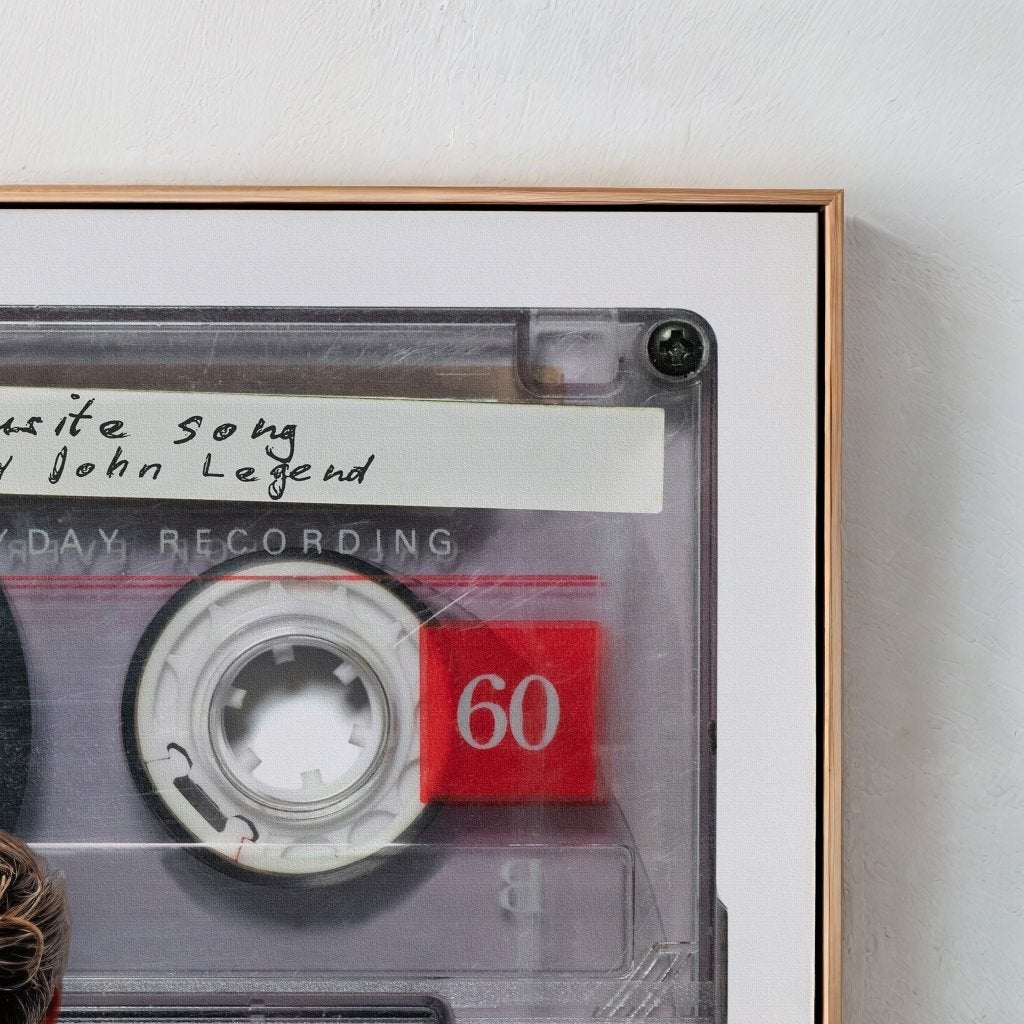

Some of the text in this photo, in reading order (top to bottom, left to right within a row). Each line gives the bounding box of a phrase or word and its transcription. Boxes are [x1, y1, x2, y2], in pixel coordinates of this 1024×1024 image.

[173, 415, 297, 463] song
[49, 446, 162, 483] John
[204, 453, 376, 500] Legend
[159, 528, 454, 555] RECORDING
[456, 673, 561, 751] 60
